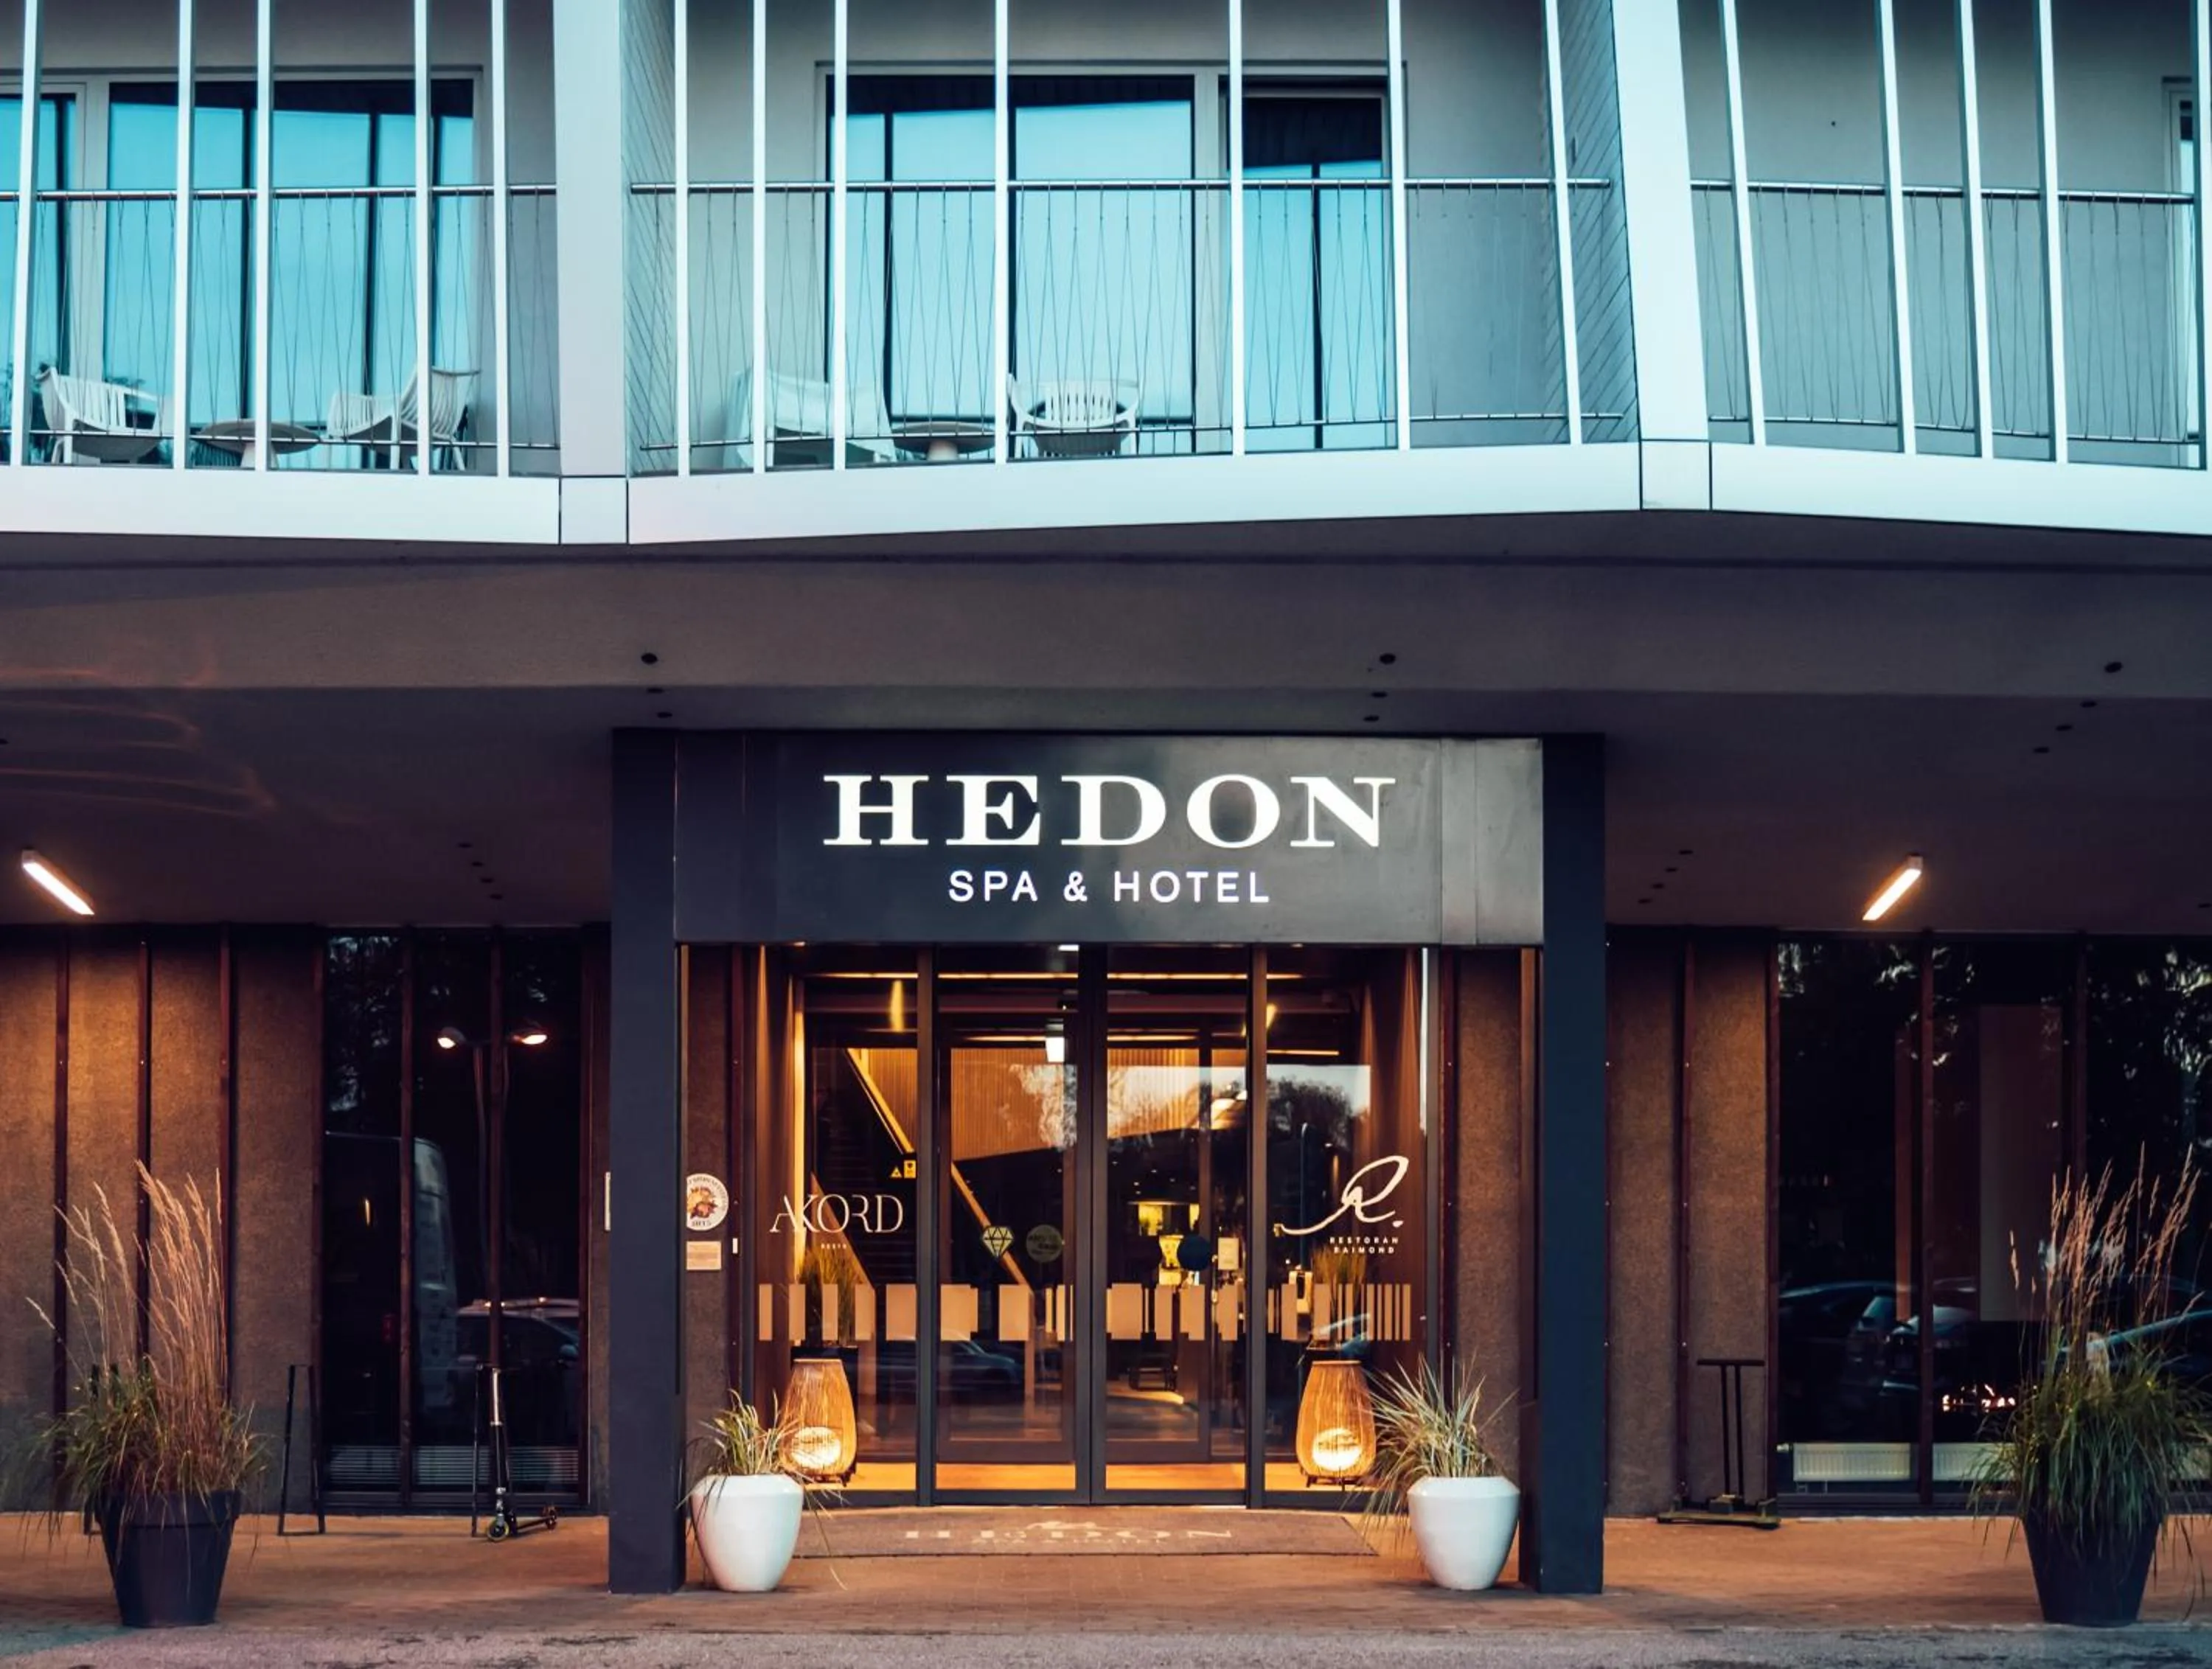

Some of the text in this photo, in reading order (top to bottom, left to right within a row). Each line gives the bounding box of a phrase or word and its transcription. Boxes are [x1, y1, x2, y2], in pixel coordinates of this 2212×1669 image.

[823, 775, 1396, 848] HEDON
[949, 871, 1270, 902] SPA & HOTEL
[769, 1194, 904, 1233] AKORD
[1329, 1236, 1399, 1244] RESTORAN
